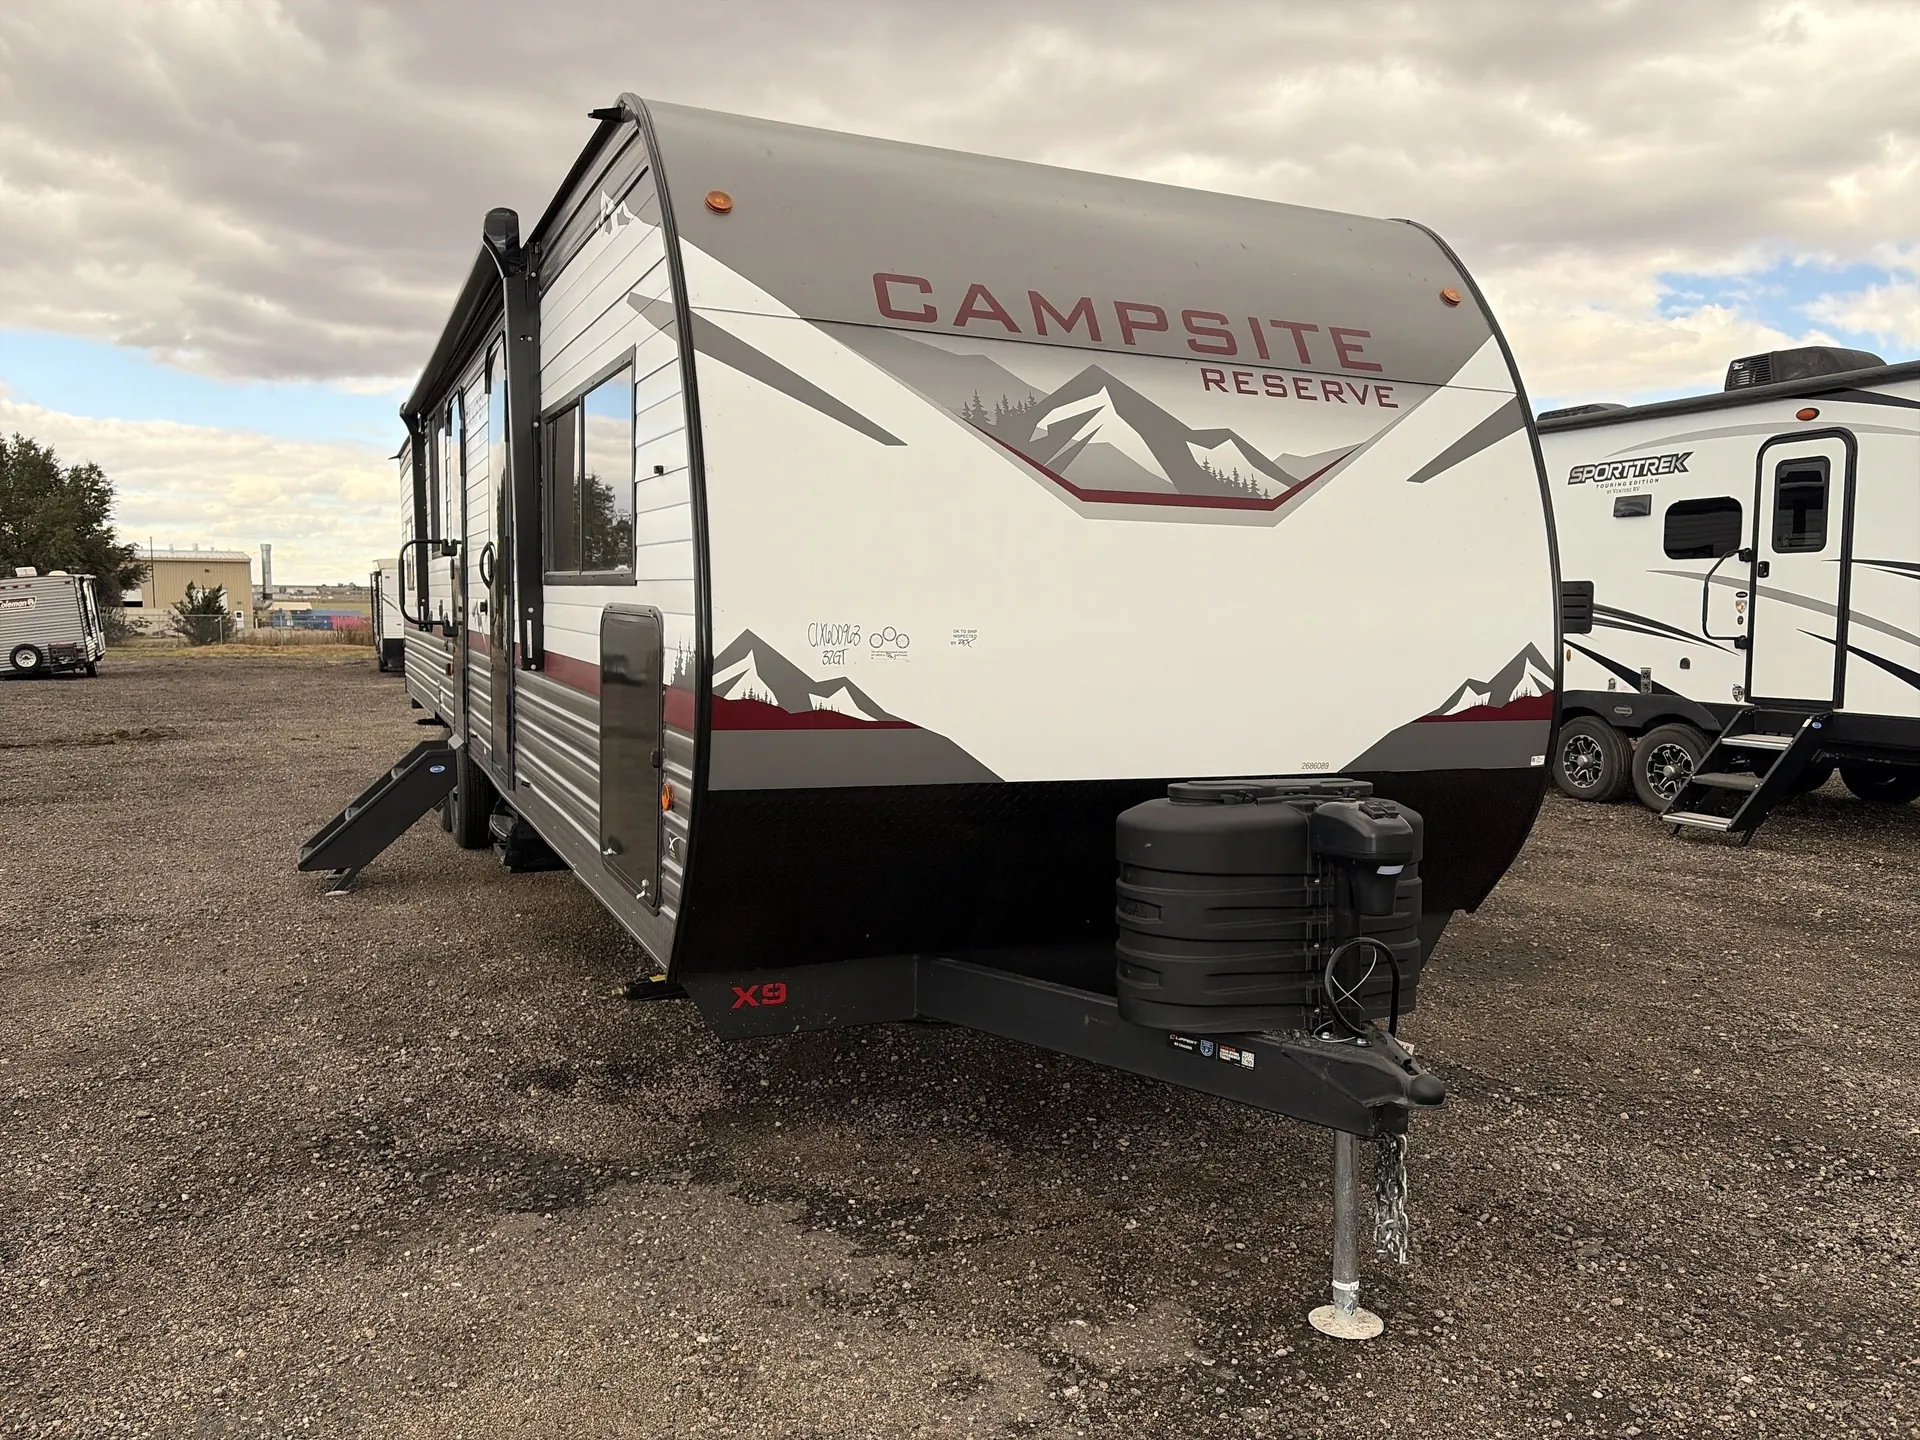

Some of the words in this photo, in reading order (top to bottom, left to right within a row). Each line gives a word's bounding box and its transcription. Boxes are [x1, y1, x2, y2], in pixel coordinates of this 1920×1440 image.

[873, 272, 1384, 373] CAMPSITE
[1200, 367, 1399, 409] RESERVE
[1567, 451, 1695, 486] SPORTTREK
[1596, 481, 1627, 489] TOURING
[1628, 478, 1660, 486] EDITION
[0, 600, 27, 608] oleman
[822, 648, 849, 665] 32GT
[731, 982, 787, 1009] X9
